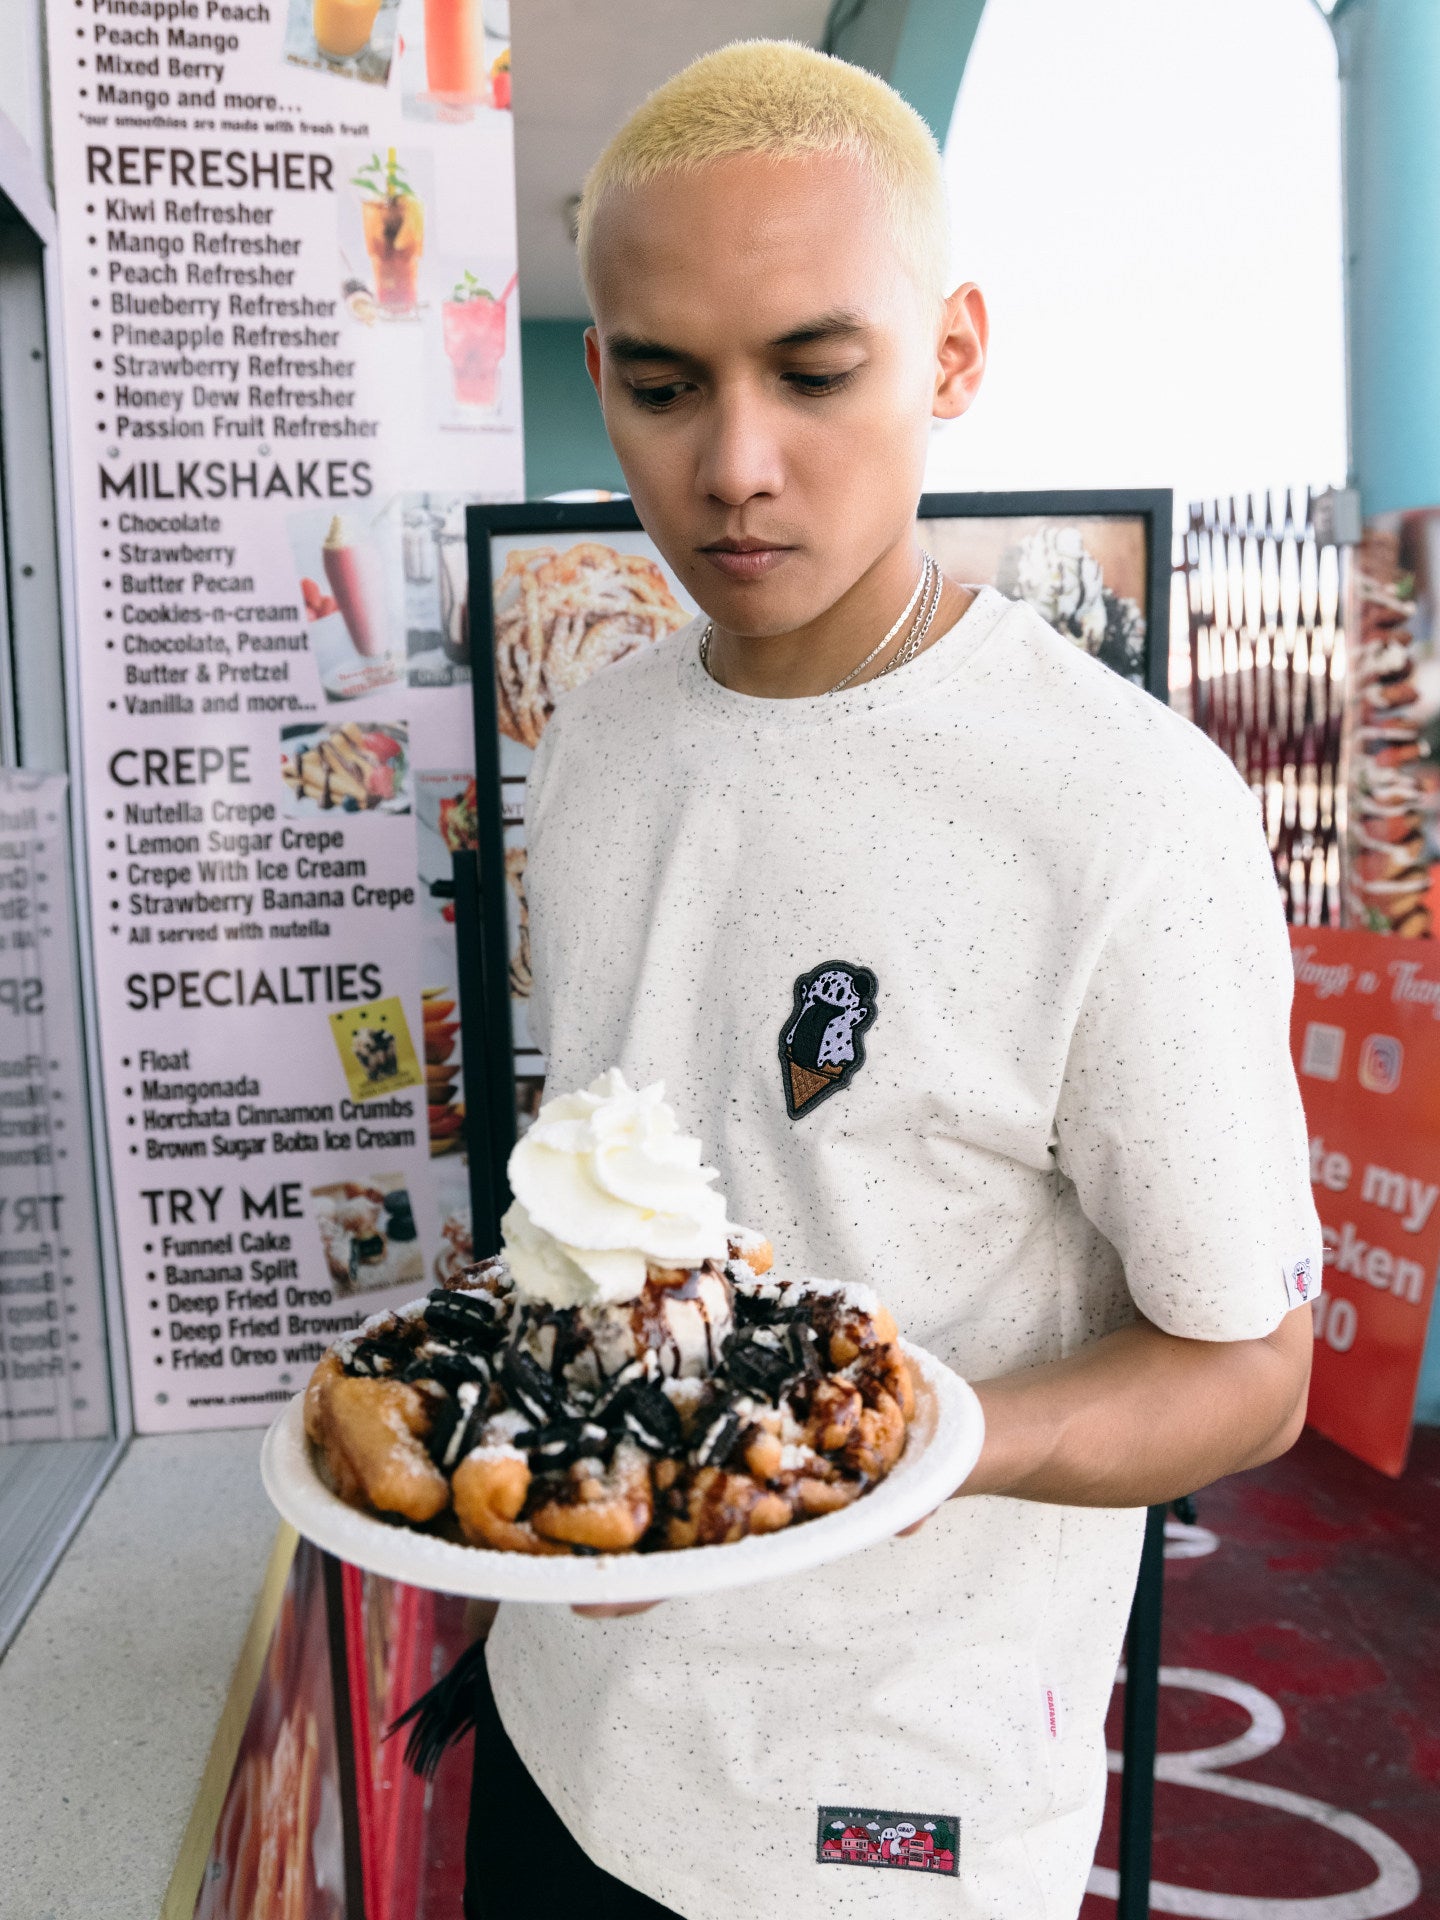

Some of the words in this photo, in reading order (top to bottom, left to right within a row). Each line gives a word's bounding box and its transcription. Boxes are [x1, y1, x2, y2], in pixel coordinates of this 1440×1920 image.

[206, 1, 270, 23] Peach
[94, 25, 161, 46] Peach
[167, 27, 239, 55] Mango
[95, 54, 161, 77] Mixed
[168, 57, 224, 84] Berry
[97, 83, 170, 111] Mango
[177, 89, 216, 108] and
[264, 120, 294, 133] with
[87, 145, 333, 191] REFRESHER
[106, 198, 155, 222] Kiwi
[164, 199, 274, 225] Refresher
[107, 229, 184, 260] Mango
[193, 231, 301, 256] Refresher
[108, 259, 178, 285] Peach
[186, 262, 295, 287] Refresher
[110, 291, 220, 321] Blueberry
[229, 293, 336, 317] Refresher
[112, 323, 224, 353] Pineapple
[232, 324, 339, 347] Refresher
[113, 353, 240, 383] Strawberry
[248, 354, 355, 378] Refresher
[115, 385, 184, 412] Honey
[192, 385, 240, 408] Dew
[248, 384, 355, 408] Refresher
[116, 415, 204, 439] Passion
[213, 415, 264, 438] Fruit
[272, 415, 378, 438] Refresher
[99, 461, 373, 500] MILKSHAKES
[118, 512, 221, 534] Chocolate
[119, 543, 235, 568] Strawberry
[121, 573, 185, 595] Butter
[192, 572, 254, 594] Pecan
[237, 631, 309, 653] Peanut
[125, 664, 189, 685] Butter
[196, 663, 211, 684] &
[217, 661, 289, 683] Pretzel
[123, 694, 194, 716] Vanilla
[201, 692, 240, 714] and
[108, 746, 250, 787] CREPE
[124, 801, 203, 825] Nutella
[212, 800, 276, 826] Crepe
[126, 834, 200, 856] Lemon
[208, 830, 274, 857] Sugar
[280, 827, 344, 854] Crepe
[127, 863, 192, 889] Crepe
[197, 860, 249, 883] With
[256, 859, 289, 881] Ice
[296, 856, 367, 879] Cream
[129, 891, 254, 916] Strawberry
[262, 888, 345, 910] Banana
[352, 884, 415, 911] Crepe
[128, 926, 152, 944] All
[158, 924, 218, 944] served
[224, 922, 264, 940] with
[269, 919, 330, 939] nutella
[126, 963, 382, 1011] SPECIALTIES
[139, 1049, 190, 1072] Float
[141, 1078, 260, 1105] Mangonada
[143, 1107, 231, 1131] Horchata
[237, 1104, 334, 1126] Cinnamon
[339, 1098, 414, 1122] Crumbs
[145, 1138, 207, 1160] Brown
[212, 1135, 267, 1161] Sugar
[324, 1129, 351, 1151] Ice
[356, 1127, 415, 1150] Cream
[140, 1186, 224, 1225] TRY
[241, 1182, 303, 1220] ME
[1361, 1163, 1440, 1233] my
[161, 1233, 234, 1257] Funnel
[239, 1231, 291, 1254] Cake
[164, 1264, 244, 1286] Banana
[250, 1258, 298, 1285] Split
[167, 1293, 220, 1317] Deep
[225, 1287, 279, 1310] Fried
[285, 1287, 332, 1308] Oreo
[169, 1321, 222, 1345] Deep
[228, 1316, 281, 1338] Fried
[171, 1347, 224, 1370] Fried
[230, 1345, 278, 1367] Oreo
